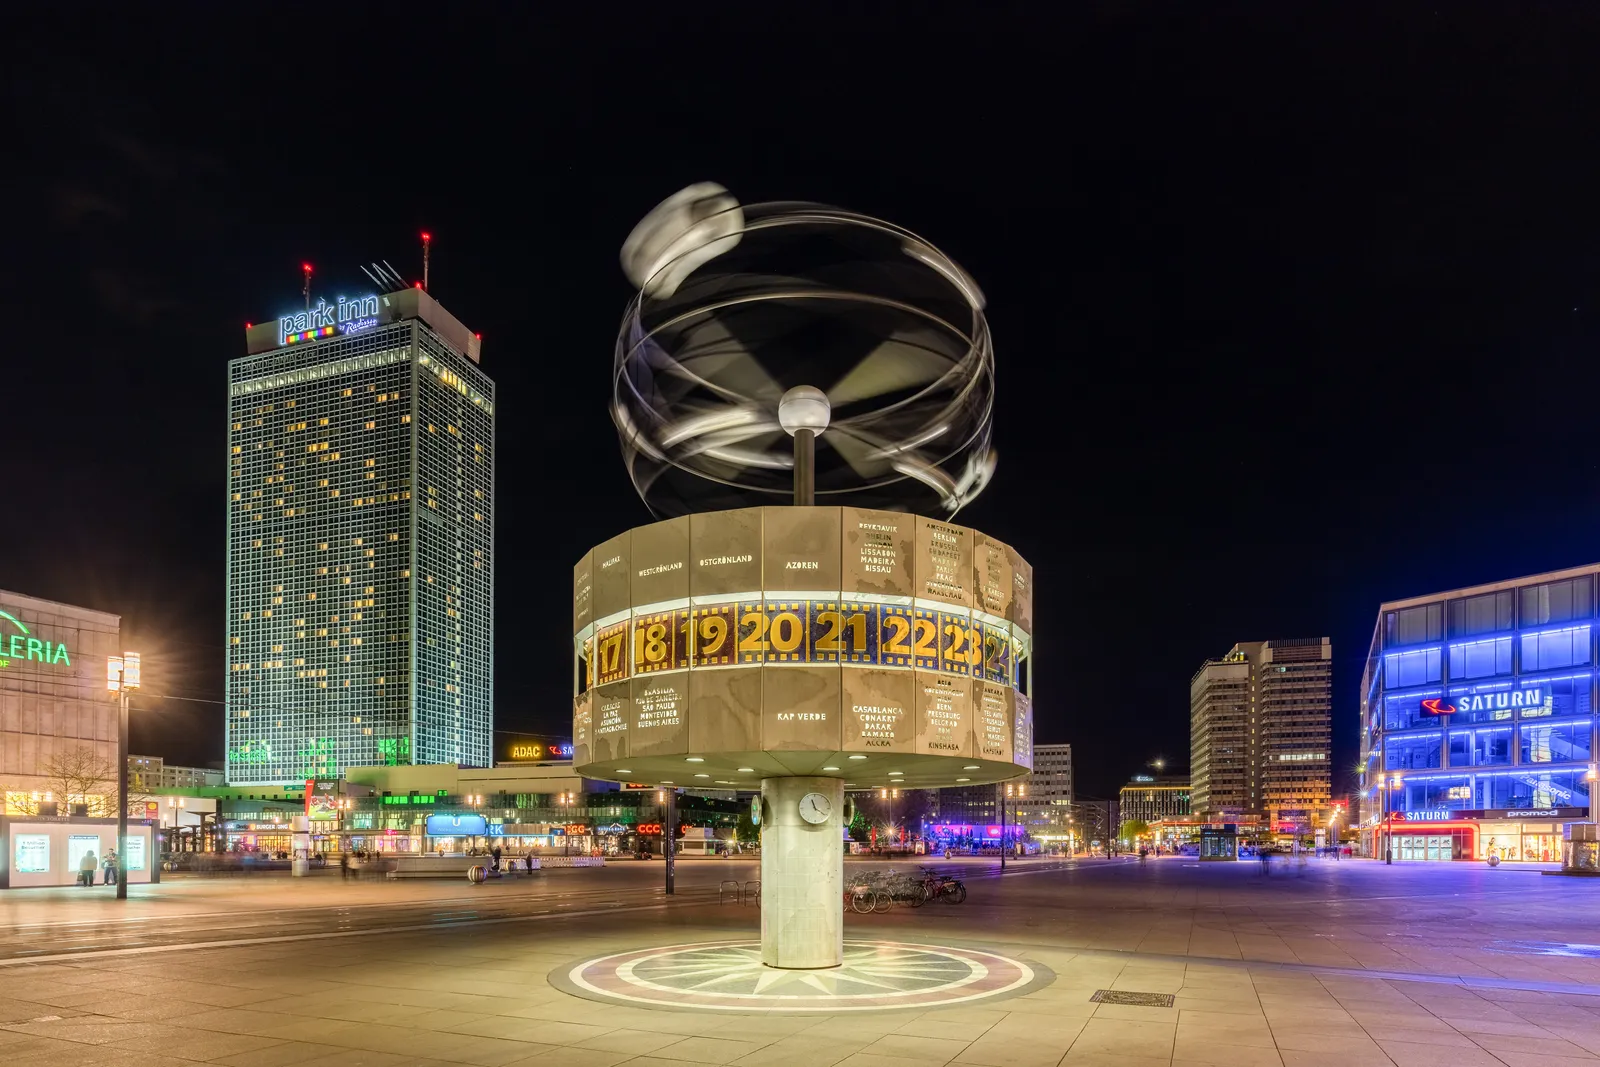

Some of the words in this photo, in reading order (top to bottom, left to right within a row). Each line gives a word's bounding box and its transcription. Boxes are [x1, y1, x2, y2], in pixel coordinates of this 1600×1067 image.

[278, 302, 335, 345] park
[338, 295, 379, 322] inn
[345, 319, 378, 334] Radisson
[859, 523, 897, 533] REYKJAVIK
[926, 523, 964, 536] AMSTERDAM
[933, 533, 957, 543] BERLIN
[860, 548, 896, 557] LISSABON
[700, 555, 753, 567] OSTGRÖNLAND
[786, 561, 819, 570] AZOREN
[860, 556, 896, 565] MADEIRA
[639, 562, 683, 577] WESTGRÖNLAND
[865, 565, 892, 574] BISSAU
[936, 565, 954, 575] PARIS
[936, 573, 954, 582] PRAG
[680, 615, 728, 656] 19
[739, 612, 803, 651] 20
[815, 612, 867, 651] 21
[882, 616, 937, 657] 22
[635, 624, 667, 665] 18
[943, 625, 982, 666] 23
[600, 632, 623, 674] 17
[1459, 689, 1540, 712] SATURN
[656, 702, 675, 711] PAULO
[852, 705, 903, 715] CASABLANCA
[936, 703, 952, 711] BERN
[609, 710, 618, 718] PAZ
[640, 710, 677, 720] MONTEVIDEO
[777, 713, 795, 721] KAP
[798, 713, 826, 721] VERDE
[860, 714, 896, 723] CONAKRY
[928, 710, 961, 720] PRESSBURG
[638, 720, 660, 729] BUENOS
[661, 718, 680, 726] AIRES
[865, 723, 892, 731] DAKAR
[931, 718, 958, 727] BELGRAD
[861, 731, 895, 739] BAMAKO
[928, 742, 960, 751] KINSHASA
[513, 746, 541, 758] ADAC
[1519, 774, 1572, 800] Panasonic
[1406, 811, 1449, 820] SATURN
[1507, 809, 1558, 817] promod
[452, 818, 461, 827] U
[638, 824, 660, 833] CCC
